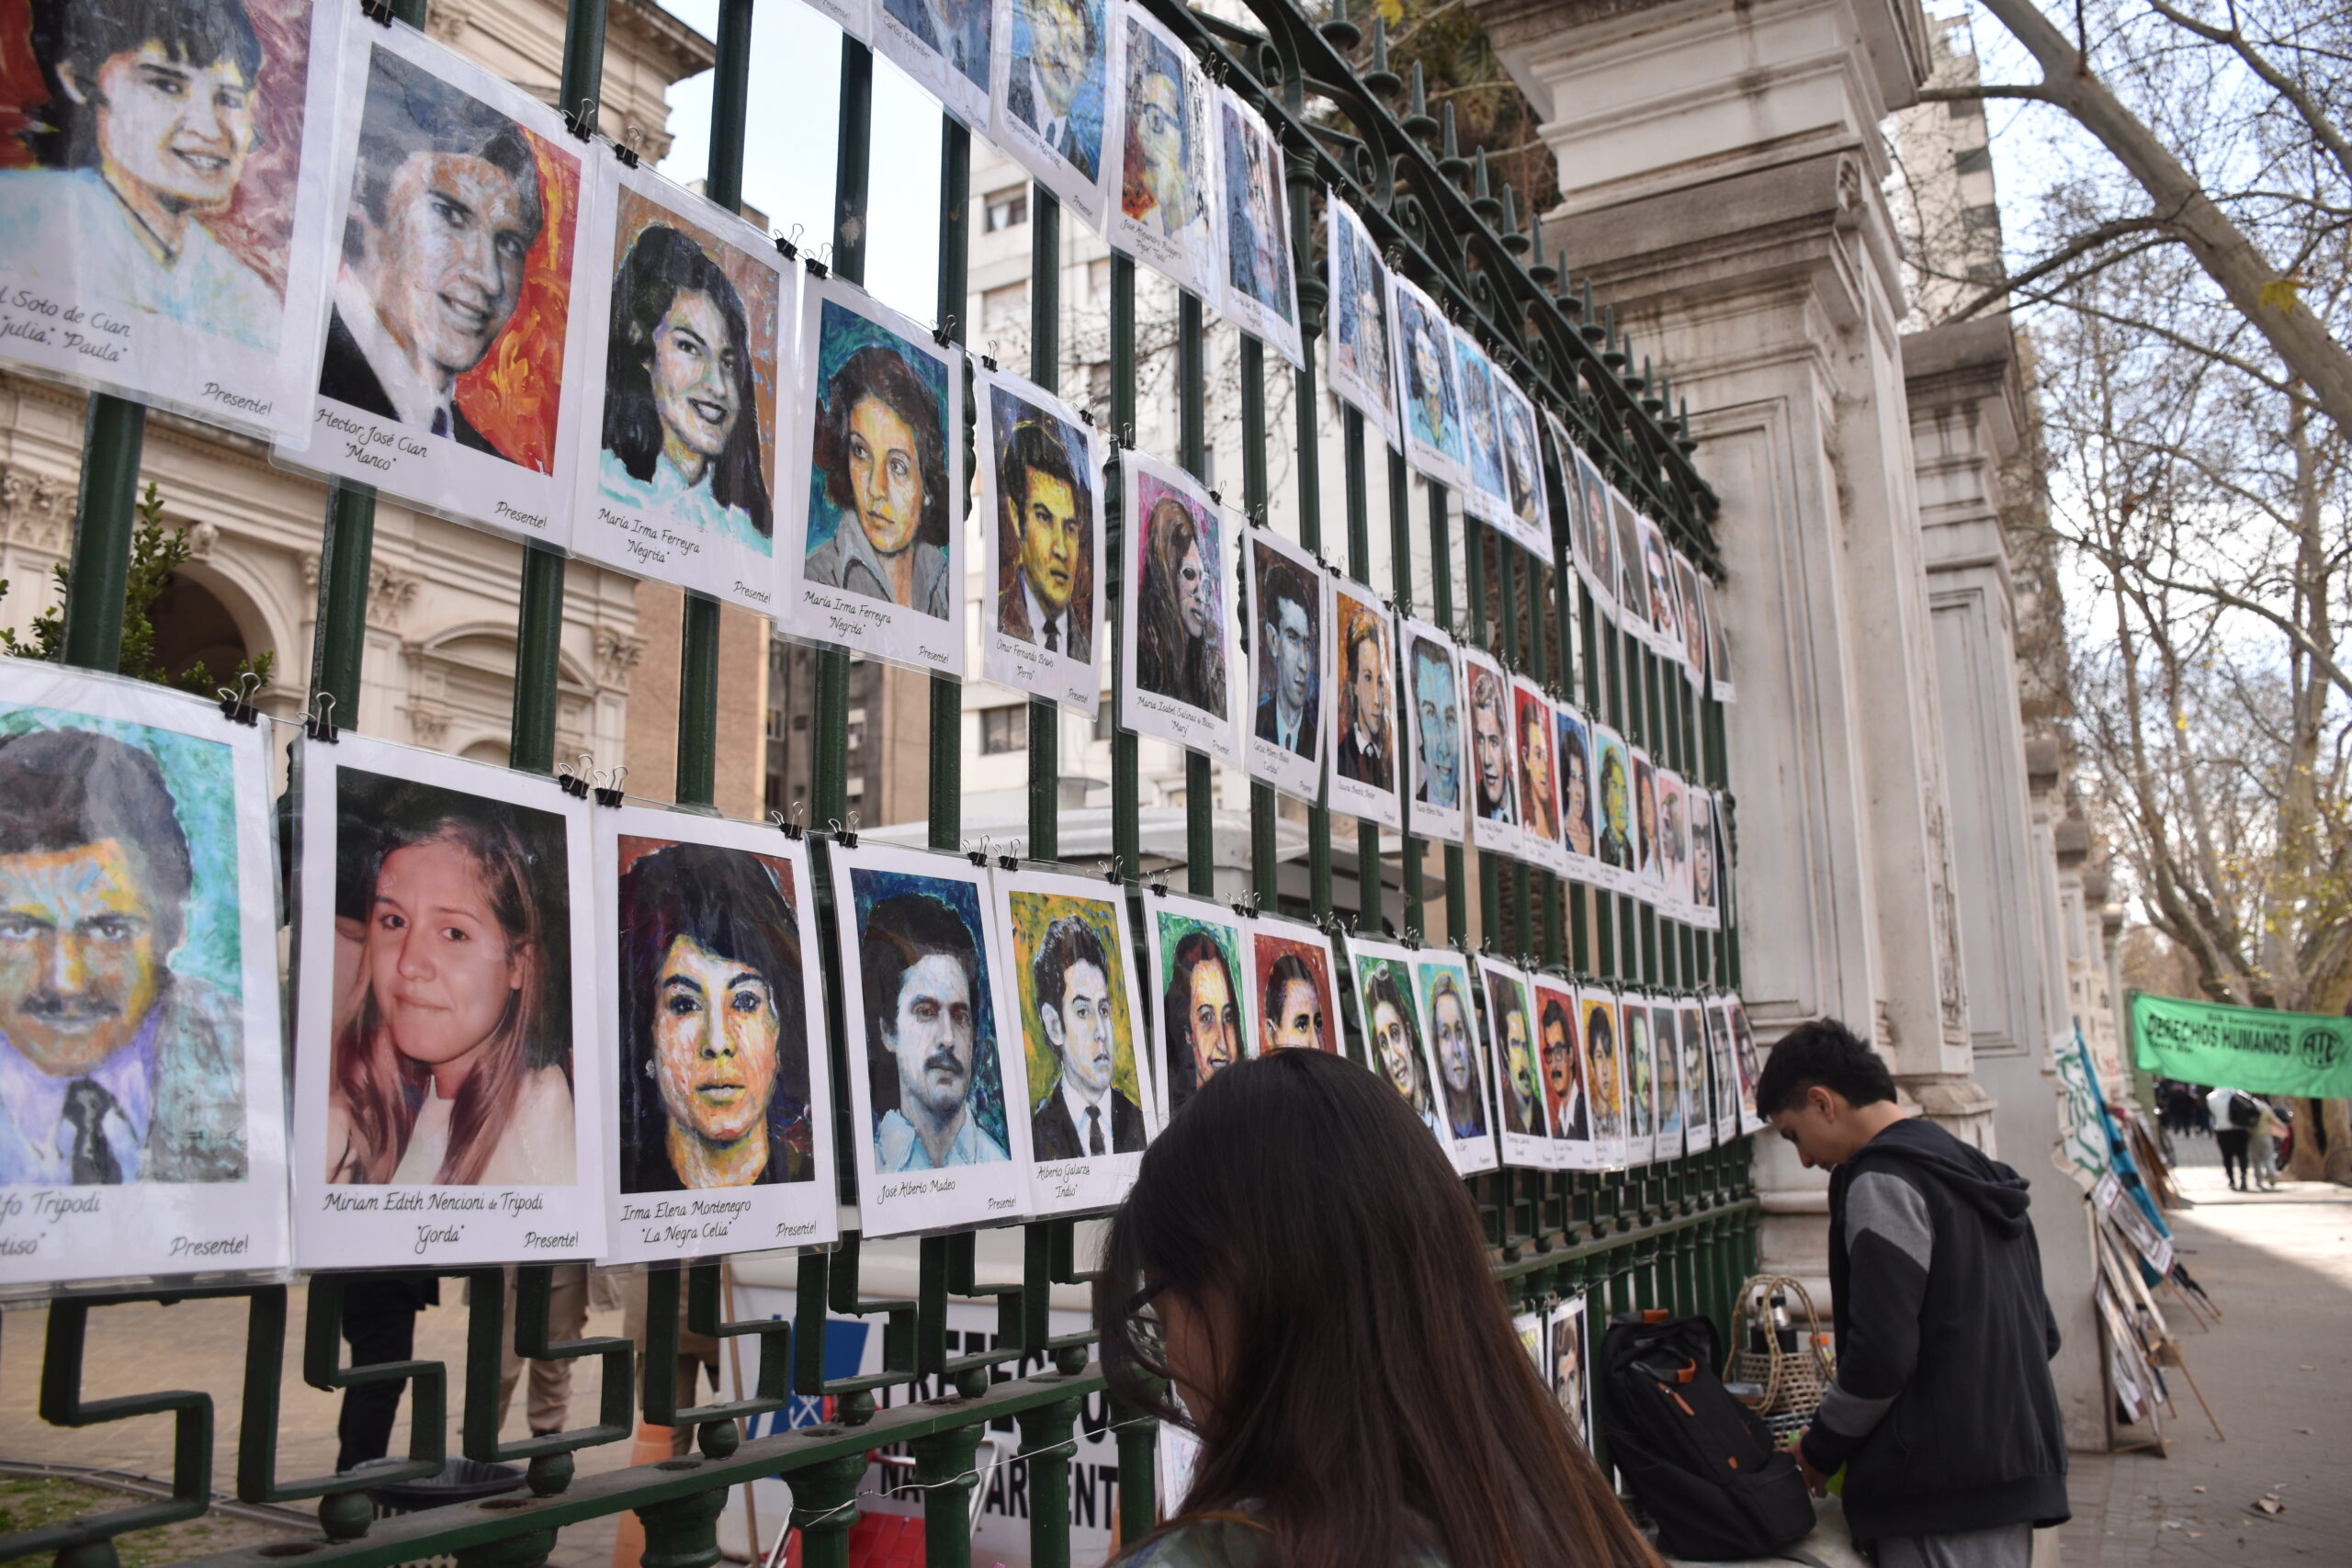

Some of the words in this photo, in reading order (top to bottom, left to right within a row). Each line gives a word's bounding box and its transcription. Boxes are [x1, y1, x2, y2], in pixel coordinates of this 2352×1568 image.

[821, 0, 852, 21] resente!
[883, 15, 902, 39] Carlos
[11, 289, 58, 316] Soto
[62, 305, 84, 324] de
[91, 312, 131, 338] Cian
[62, 331, 128, 363] "Paula"
[200, 381, 273, 415] Presente!
[315, 408, 363, 436] Hector
[358, 425, 395, 446] José
[398, 436, 427, 458] Cian
[345, 442, 397, 471] "Manco"
[494, 501, 548, 530] Presente!
[597, 508, 629, 529] Maria
[630, 519, 658, 539] Irma
[661, 529, 700, 556] Ferreyra
[627, 538, 670, 564] "Negrita"
[733, 581, 771, 604] Presente!
[803, 591, 831, 608] Maria
[832, 598, 856, 615] Irma
[858, 604, 891, 627] Ferreyra
[829, 615, 866, 637] "Negrita"
[919, 645, 949, 664] Presente!
[996, 638, 1012, 653] Omar
[1012, 644, 1037, 662] Fernando
[1067, 688, 1088, 704] Presente!
[2147, 1013, 2218, 1047] DERECHOS
[2222, 1027, 2290, 1055] HUMANOS
[1036, 1165, 1063, 1180] Alberto
[1063, 1161, 1090, 1183] Galarza
[876, 1185, 898, 1205] José
[899, 1181, 927, 1198] Alberto
[929, 1179, 956, 1192] Madeo
[988, 1196, 1016, 1211] Presente!
[1056, 1184, 1078, 1198] "Indio"
[30, 1190, 101, 1224] Tripodi
[322, 1193, 379, 1212] Miriam
[382, 1192, 424, 1211] Edith
[426, 1193, 485, 1211] Nencioni
[488, 1200, 498, 1211] de
[500, 1192, 544, 1218] Tripodi
[620, 1204, 651, 1222] Irma
[654, 1201, 687, 1218] Elena
[690, 1200, 752, 1220] Montenegro
[414, 1225, 465, 1255] "Gorda"
[524, 1231, 579, 1249] Presente!
[641, 1228, 661, 1243] "La
[663, 1224, 698, 1248] Negra
[702, 1221, 732, 1238] Celia"
[775, 1220, 817, 1237] Presente!
[169, 1235, 249, 1257] Presente!
